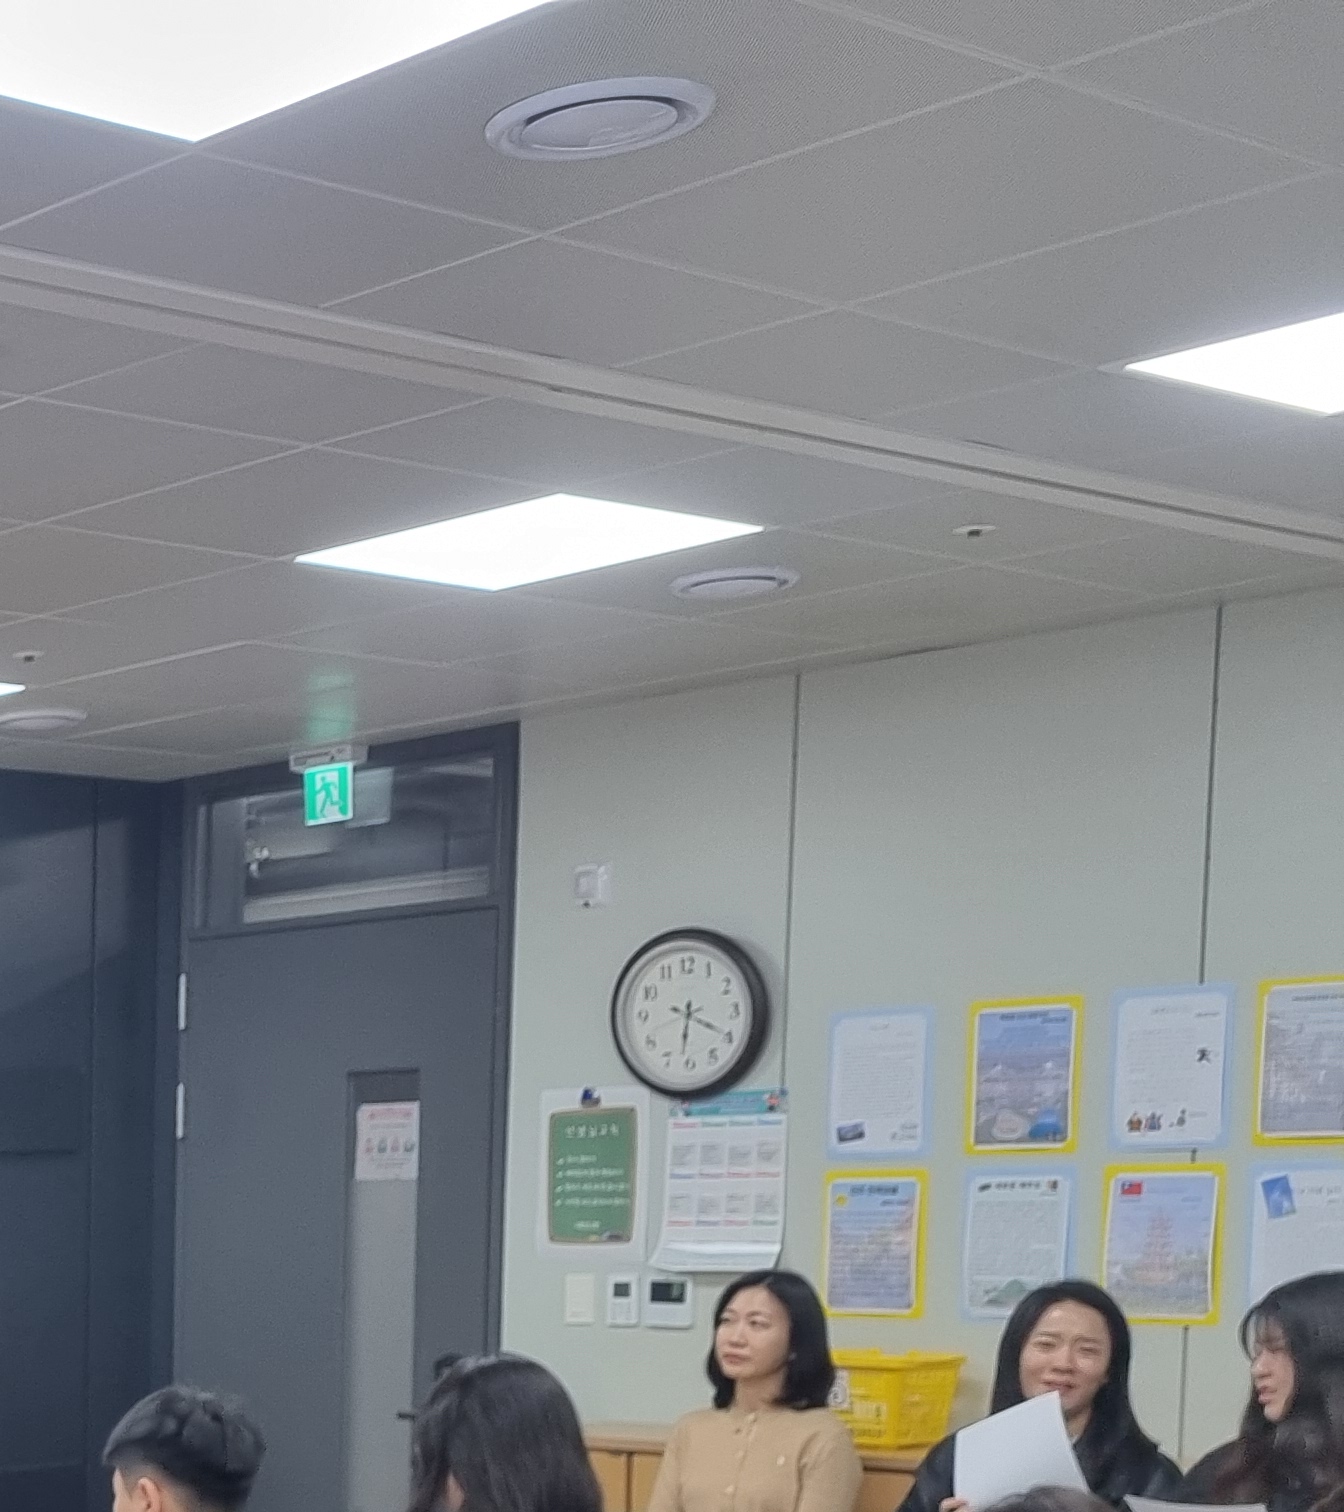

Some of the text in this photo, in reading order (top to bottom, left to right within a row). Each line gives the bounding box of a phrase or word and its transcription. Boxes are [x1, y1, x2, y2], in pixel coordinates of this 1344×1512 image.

[660, 964, 672, 980] 11
[680, 956, 696, 975] 12
[644, 983, 658, 1001] 10
[721, 976, 731, 996] 2
